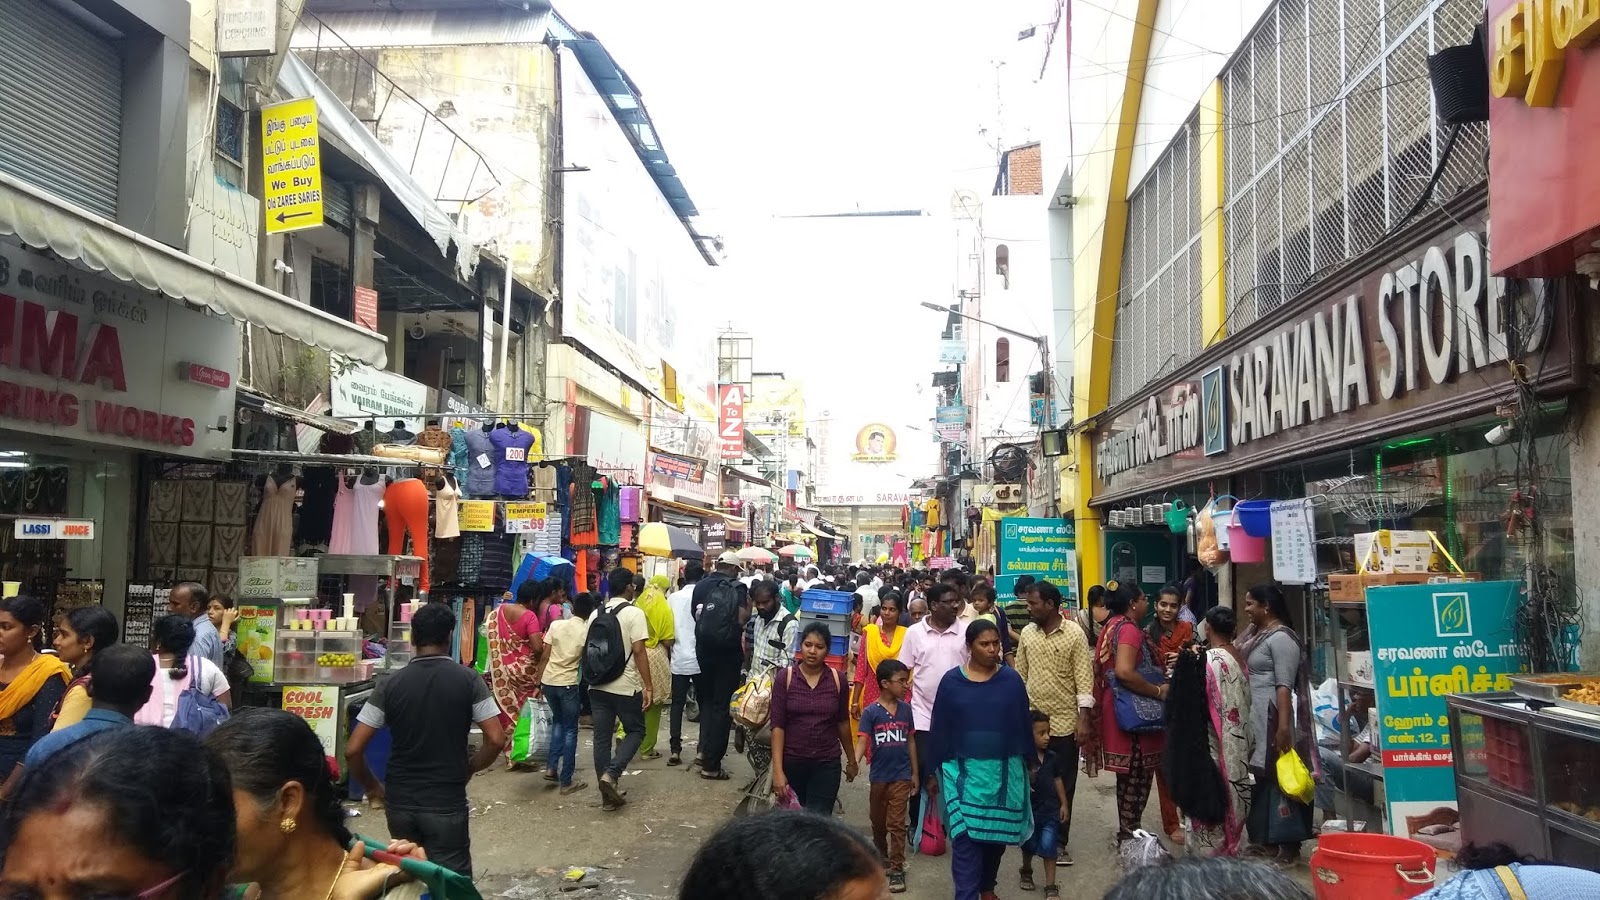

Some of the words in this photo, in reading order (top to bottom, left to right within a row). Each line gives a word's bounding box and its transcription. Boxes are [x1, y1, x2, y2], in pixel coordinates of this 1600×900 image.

[266, 117, 286, 137] இங்கு
[289, 114, 312, 129] பழைய
[267, 152, 316, 175] வாங்கப்படும்
[271, 180, 286, 191] We
[293, 176, 313, 187] Buy
[277, 193, 297, 208] ZAREE
[298, 189, 321, 205] SARIES
[0, 293, 128, 393] MA
[1230, 294, 1369, 448] SARAVANA
[722, 387, 742, 406] A
[351, 393, 383, 412] VAIRAM
[383, 403, 413, 421] BANGLES
[726, 407, 737, 417] To
[95, 399, 195, 447] WORKS
[721, 417, 742, 437] Z
[509, 447, 524, 460] 200
[22, 524, 51, 535] LASSI
[62, 525, 90, 535] JUICE
[530, 517, 545, 530] 69
[1017, 525, 1054, 535] சரவணா
[1056, 523, 1076, 535] ஸ்டே
[244, 587, 273, 596] SODA
[1377, 646, 1448, 663] சரவணா
[1387, 664, 1528, 698] பர்னிச்ச
[285, 690, 323, 704] COOL
[1384, 712, 1434, 730] ஹோம்
[874, 729, 907, 746] RNL
[1392, 752, 1432, 762] பார்க்கிங்
